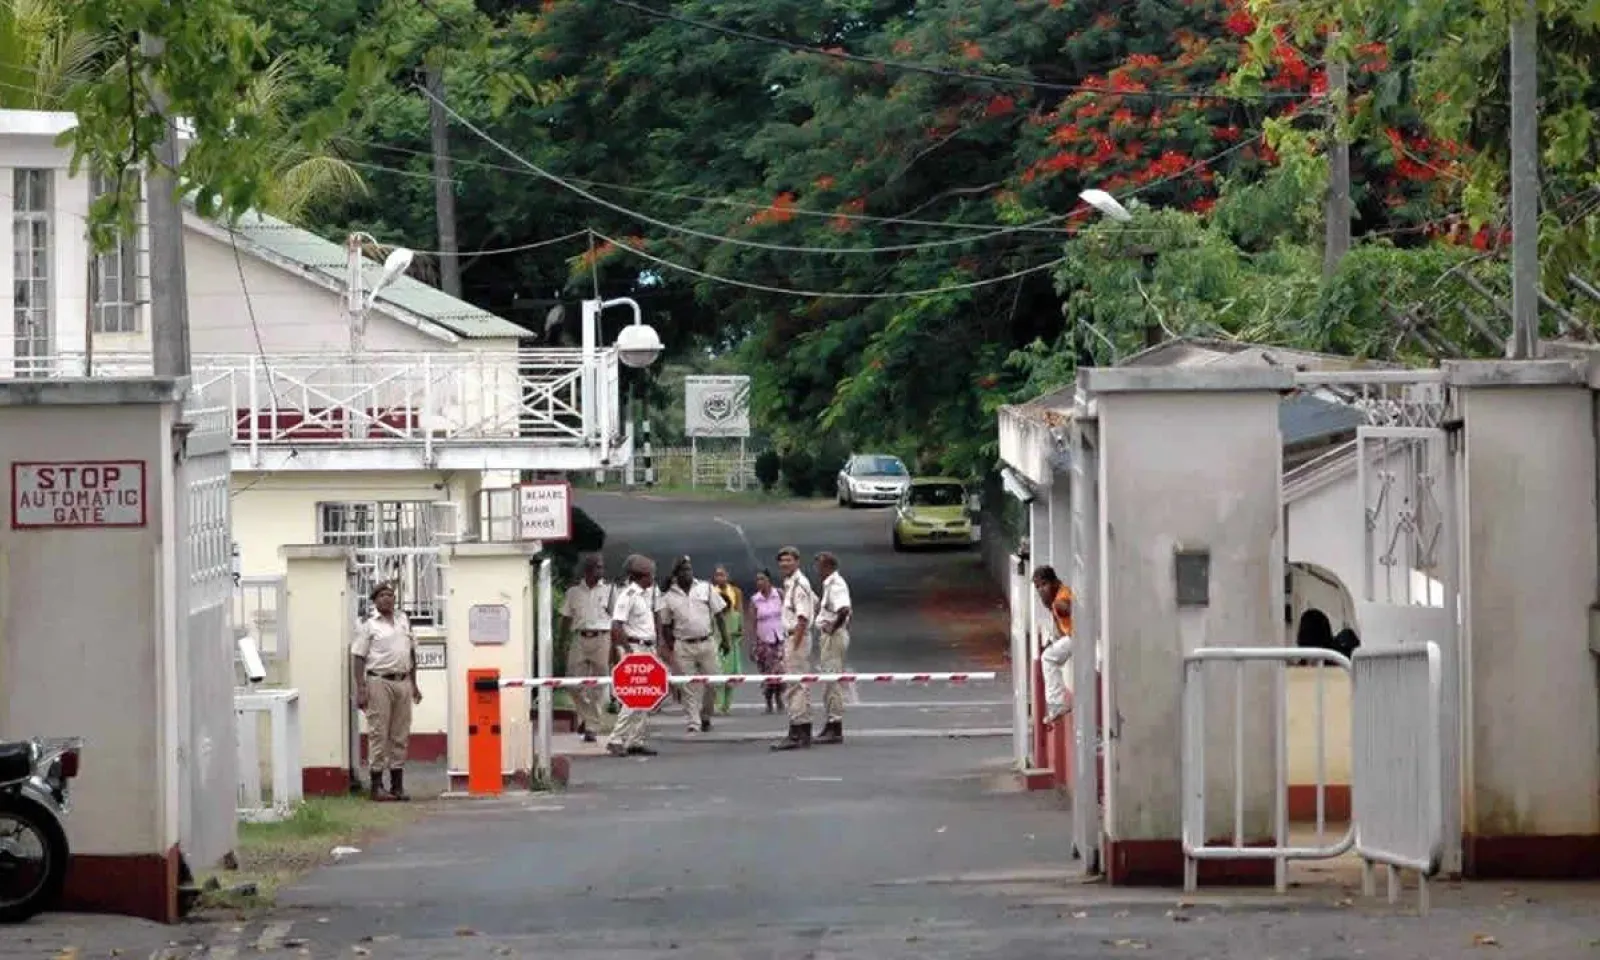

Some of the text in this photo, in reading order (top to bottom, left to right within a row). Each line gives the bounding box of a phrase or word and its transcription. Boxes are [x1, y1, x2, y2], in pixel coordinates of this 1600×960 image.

[37, 467, 120, 489] STOP
[20, 489, 138, 508] AUTOMATIC
[54, 507, 104, 522] GATE
[624, 663, 655, 674] STOP
[615, 685, 661, 697] CONTROL
